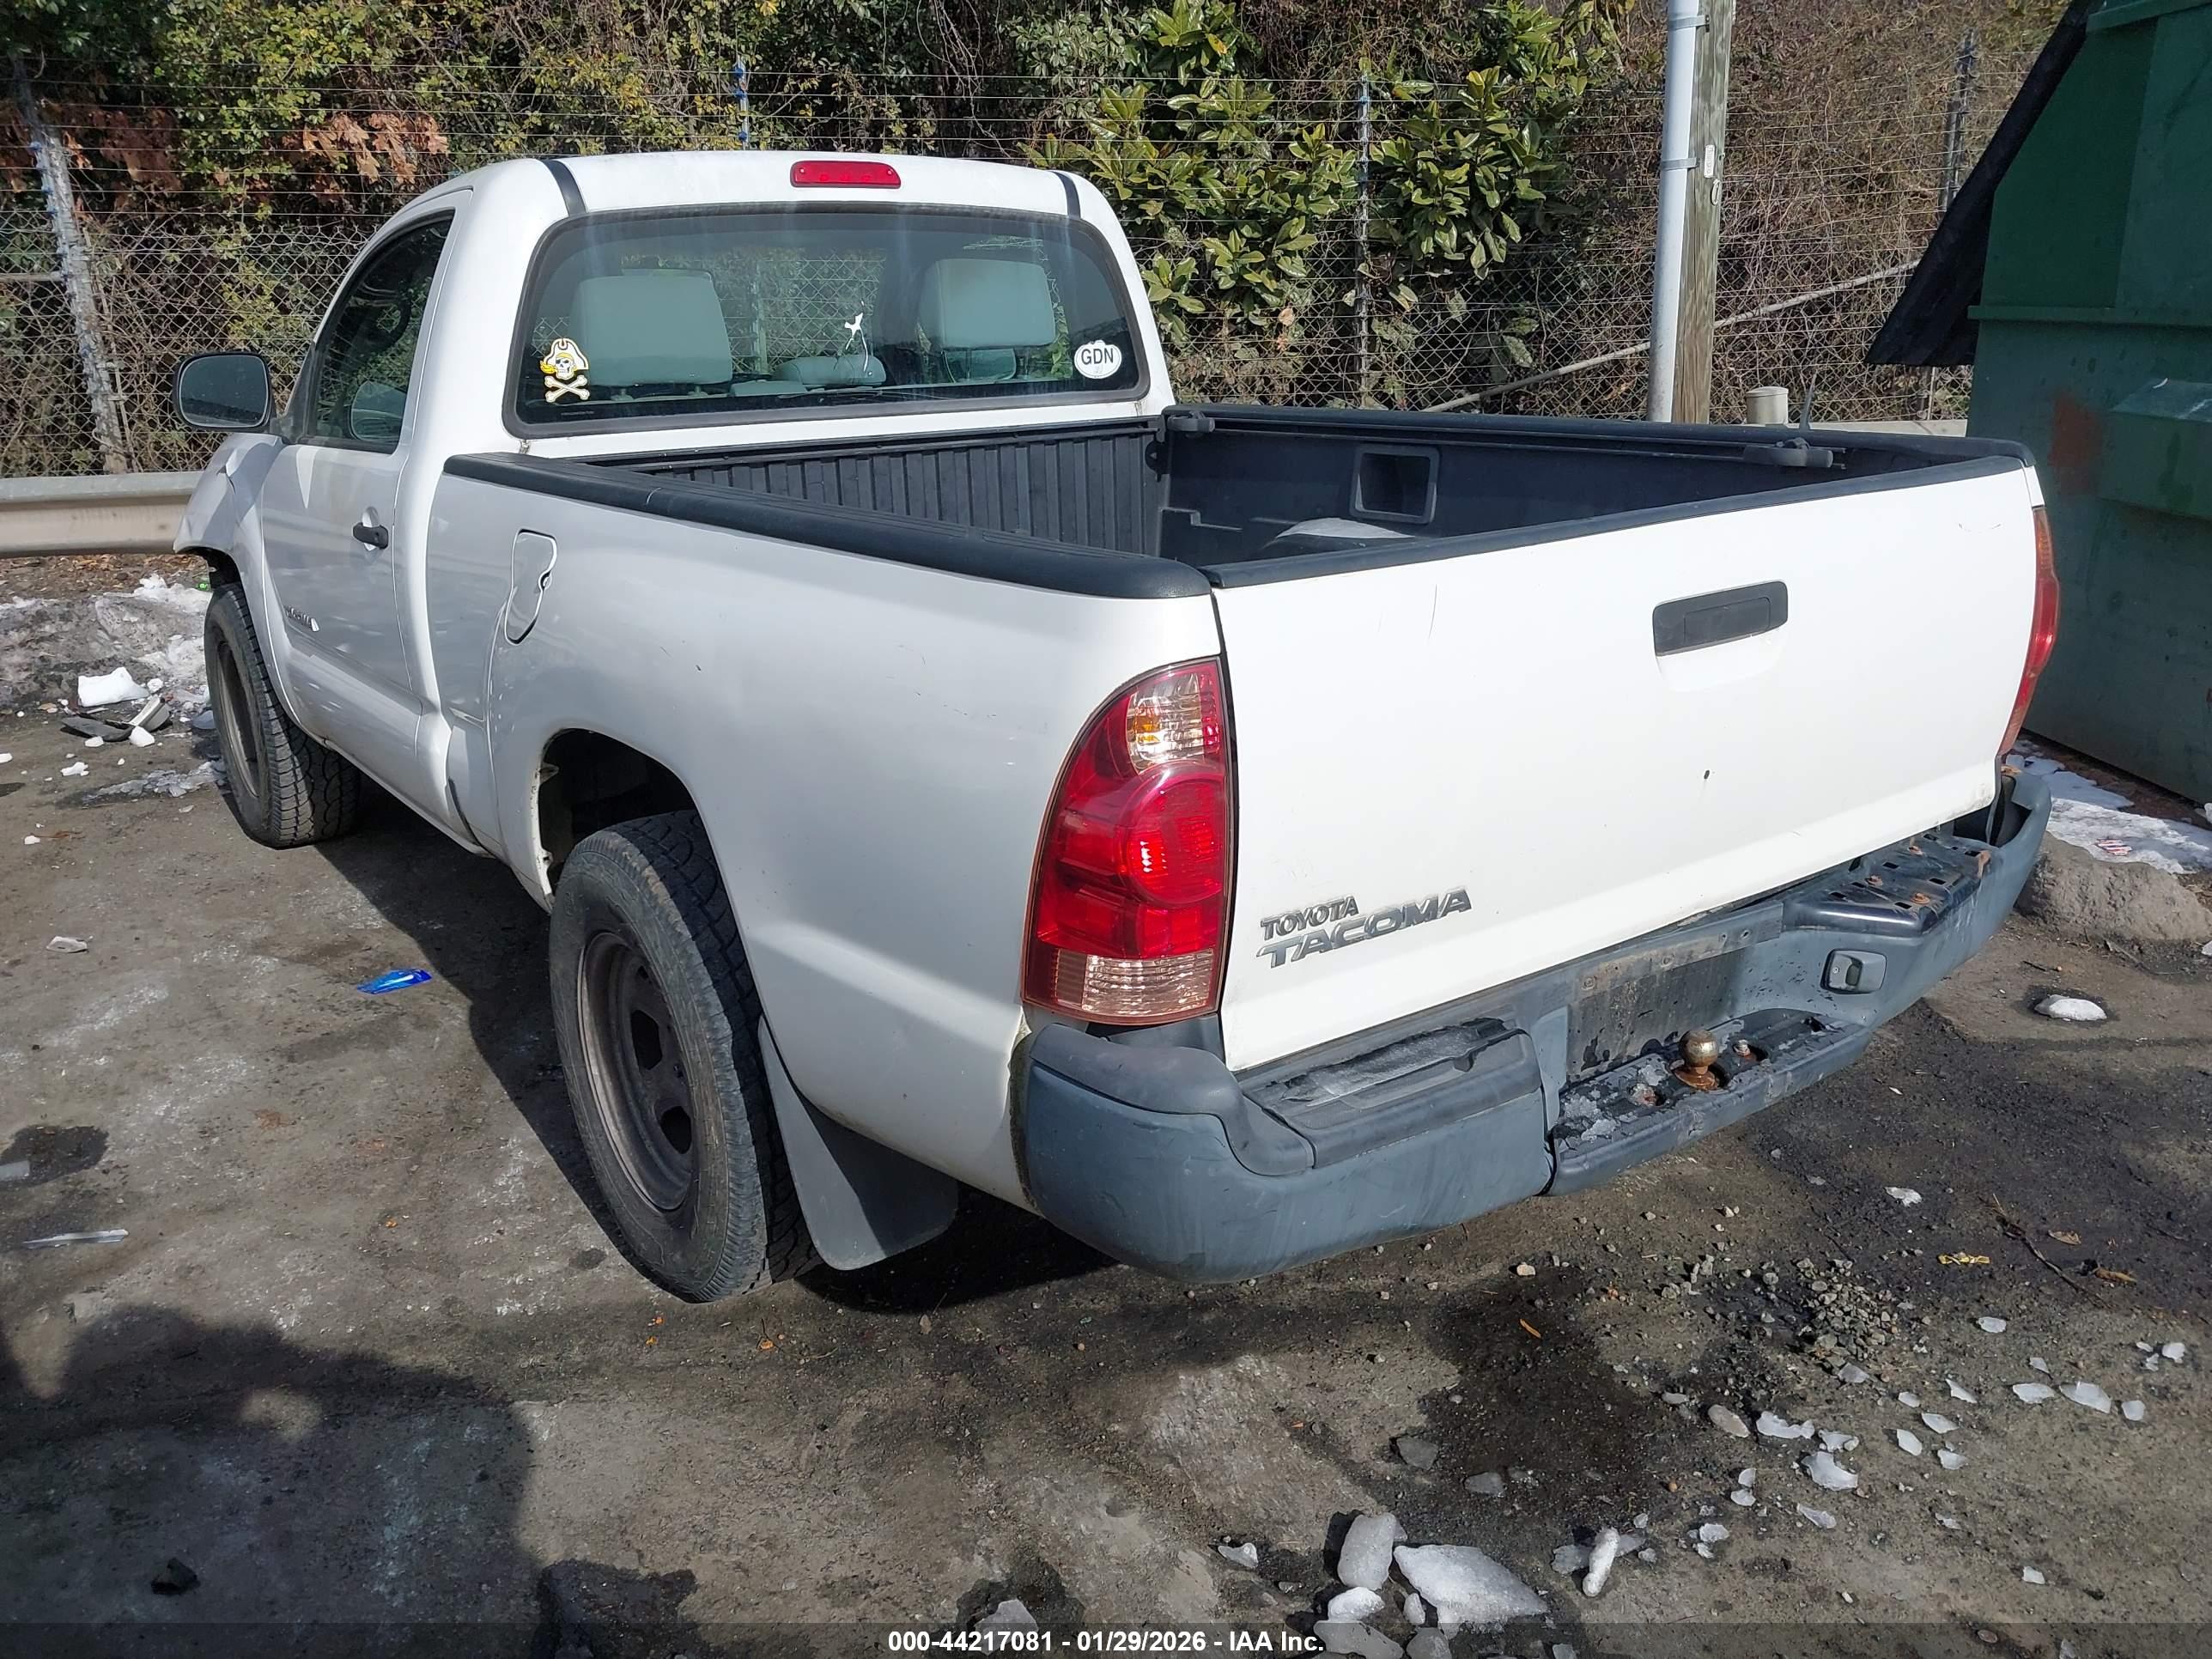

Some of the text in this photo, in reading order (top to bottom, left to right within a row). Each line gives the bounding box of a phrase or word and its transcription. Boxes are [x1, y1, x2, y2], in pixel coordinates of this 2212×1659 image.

[1081, 348, 1114, 365] GDN
[1256, 888, 1472, 969] TACOMA
[1260, 896, 1359, 940] TOYOTA
